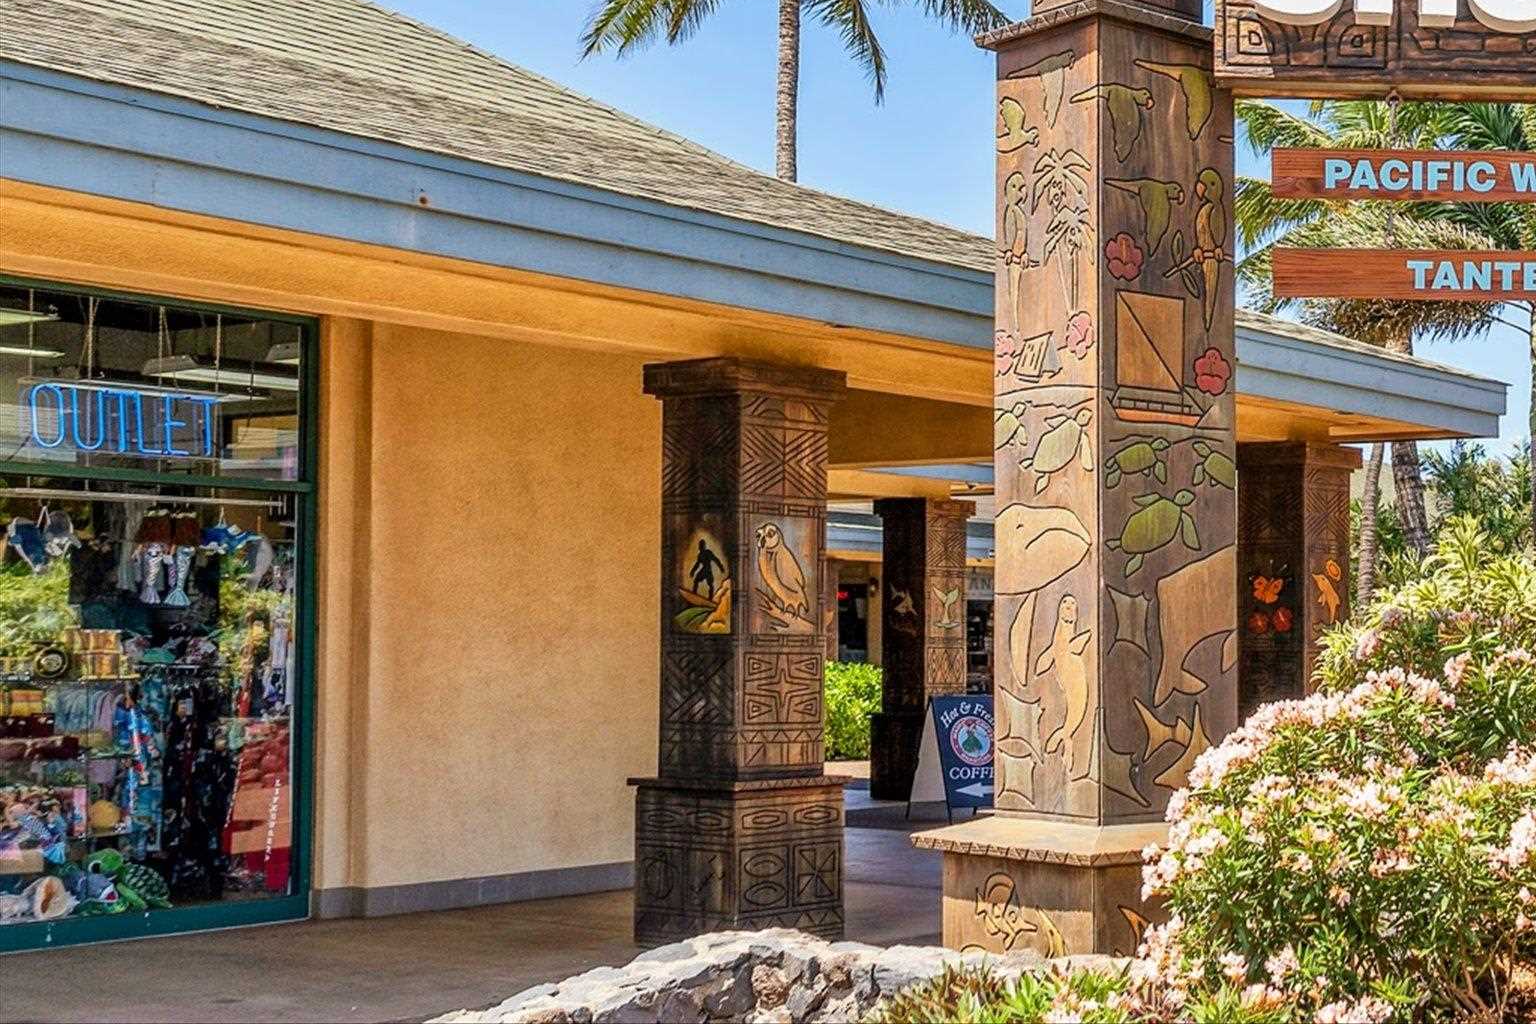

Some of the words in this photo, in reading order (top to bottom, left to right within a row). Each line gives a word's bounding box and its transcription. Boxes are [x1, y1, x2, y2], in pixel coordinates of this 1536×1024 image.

[1324, 159, 1496, 193] PACIFIC
[31, 383, 220, 456] OUTLET
[940, 707, 959, 727] Hot
[959, 701, 971, 714] &
[973, 703, 993, 725] Fres
[949, 766, 993, 780] COFF
